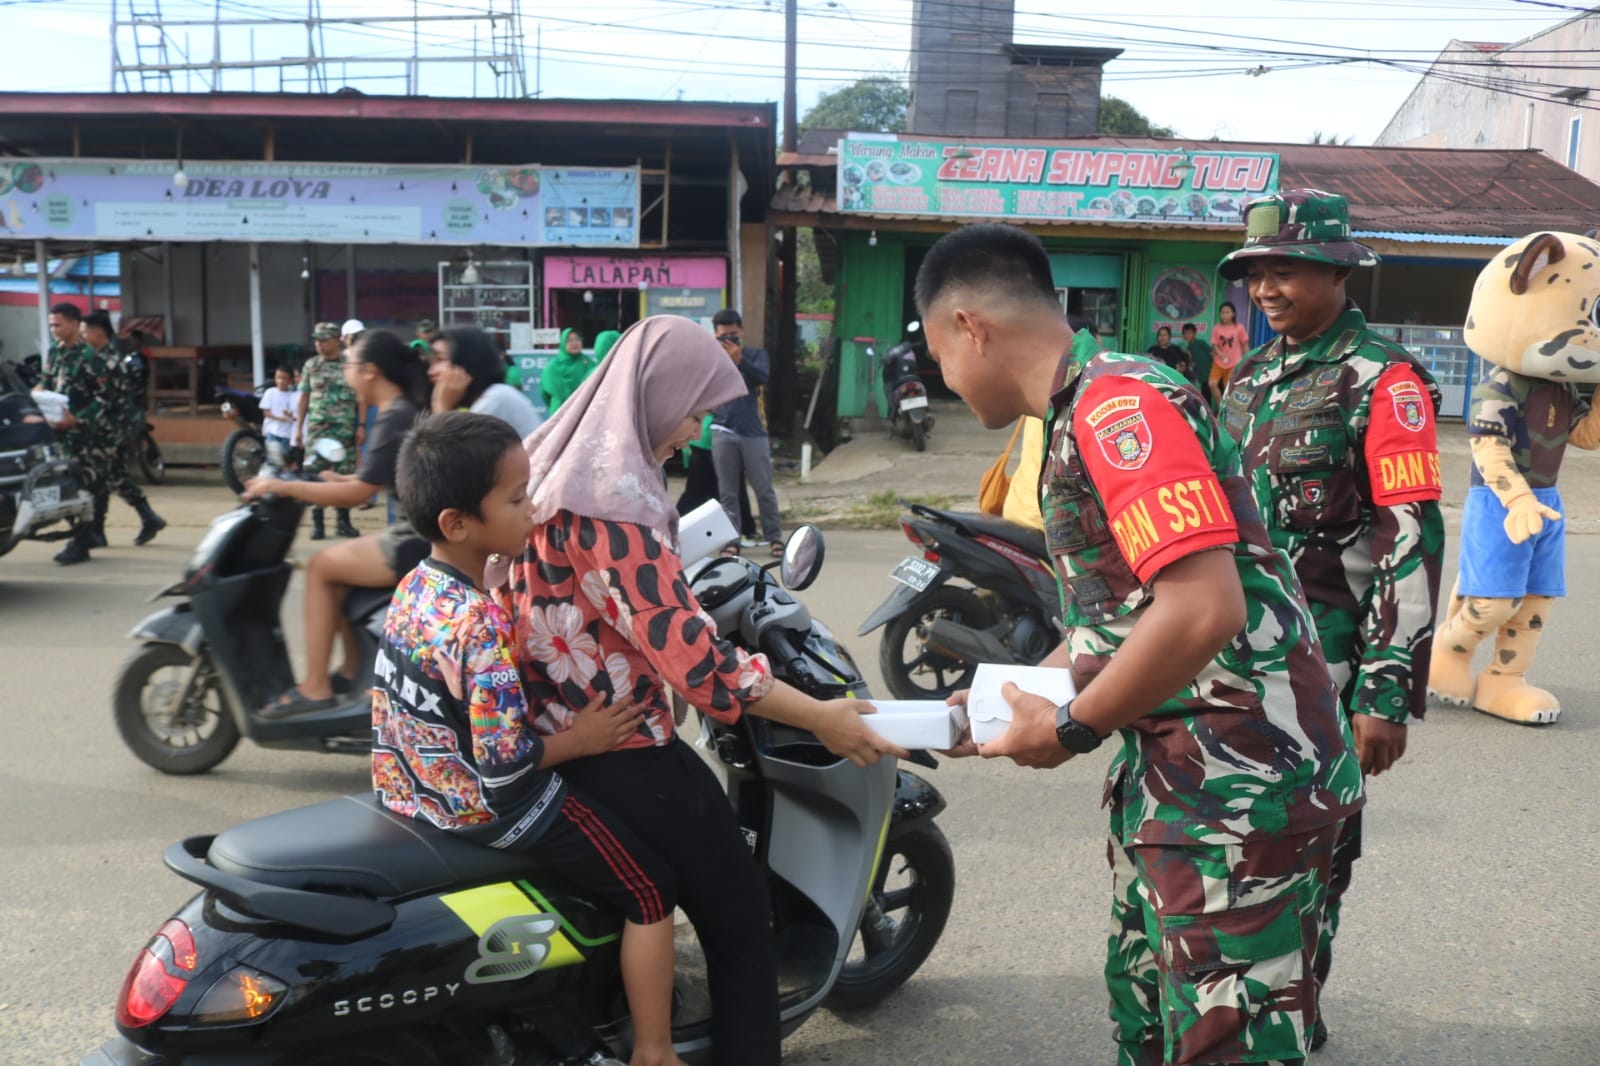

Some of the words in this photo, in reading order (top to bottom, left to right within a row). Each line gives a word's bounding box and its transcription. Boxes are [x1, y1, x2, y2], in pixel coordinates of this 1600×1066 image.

[898, 143, 937, 159] Makan
[937, 146, 1047, 184] ZEANA
[1191, 155, 1274, 192] TUGU
[183, 179, 245, 198] DEA
[249, 179, 332, 199] LOVA
[572, 264, 671, 284] LALAPAN
[521, 357, 548, 369] DE
[1089, 400, 1117, 423] KODIM
[1380, 451, 1426, 491] DAN
[1113, 498, 1160, 565] DAN
[1157, 479, 1215, 534] SST
[334, 982, 460, 1016] SCOOPY
